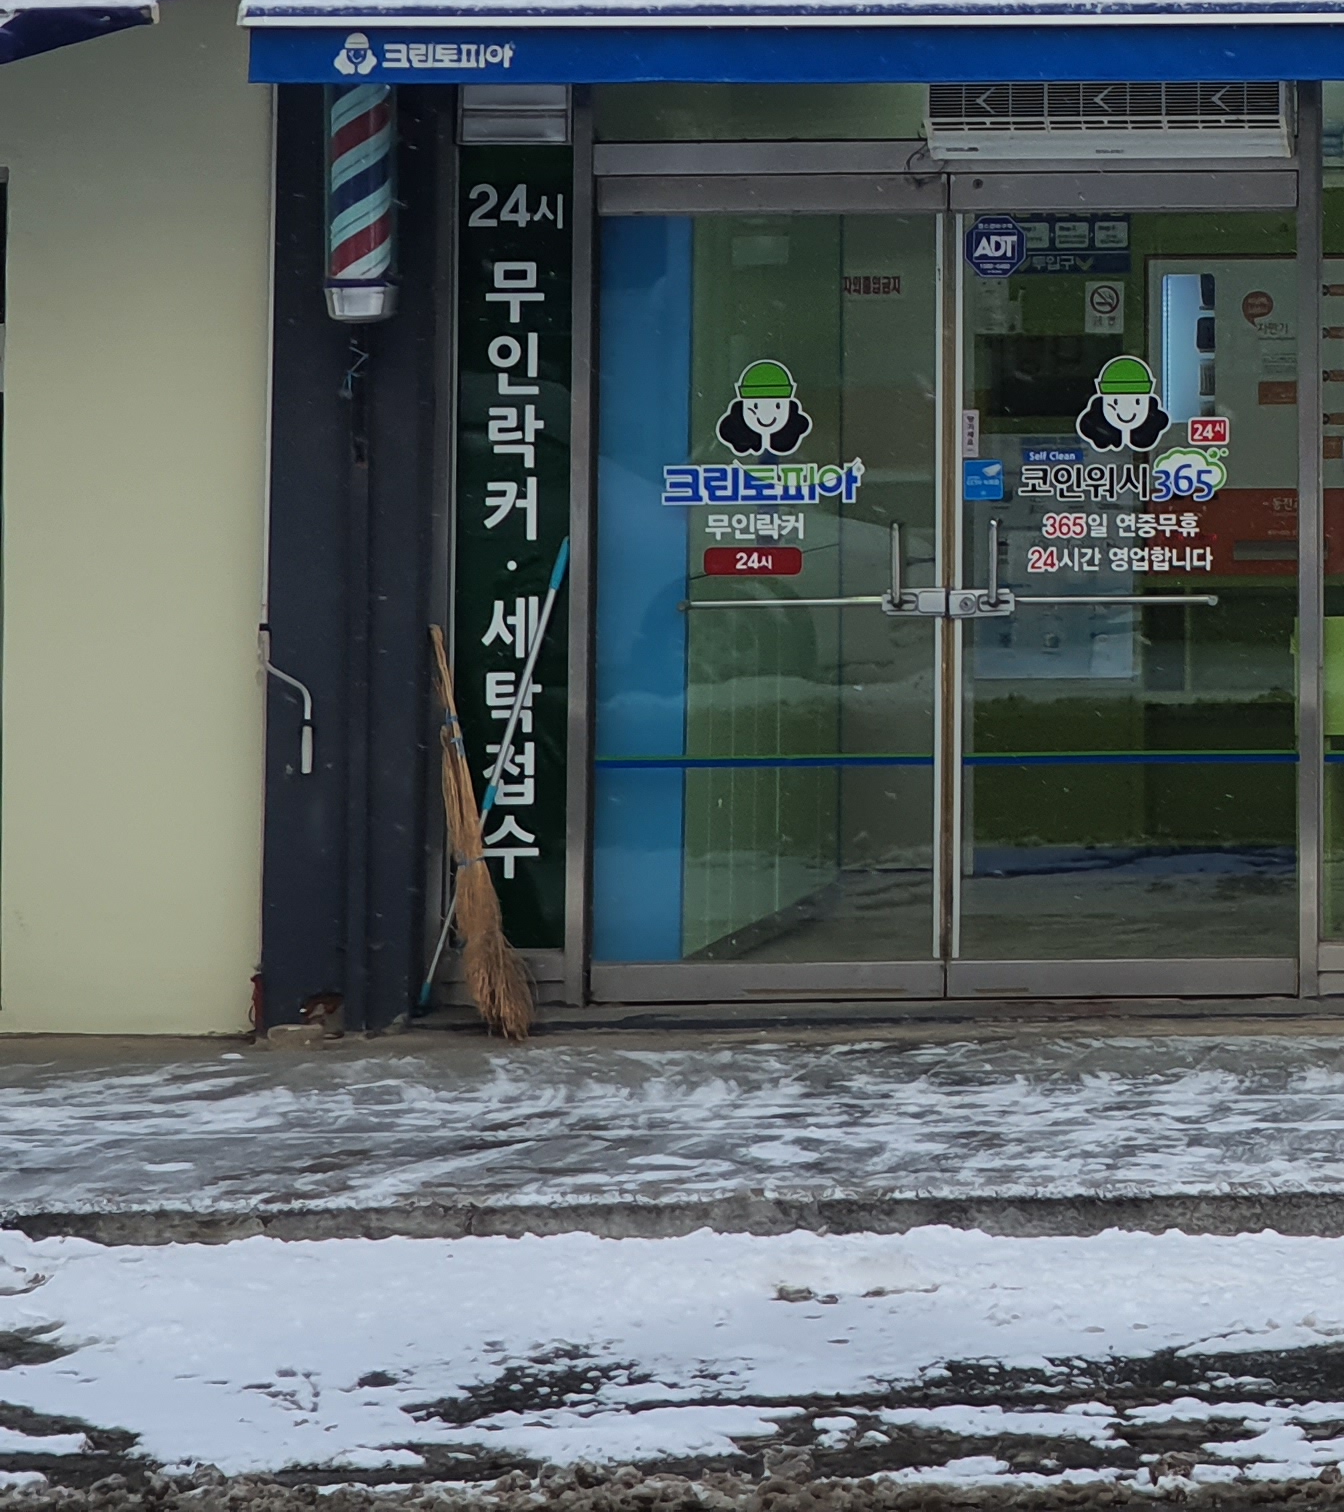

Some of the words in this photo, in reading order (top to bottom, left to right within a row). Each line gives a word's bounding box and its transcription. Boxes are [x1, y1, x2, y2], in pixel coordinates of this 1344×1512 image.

[382, 43, 514, 69] 크린토피아
[468, 183, 564, 229] 24시
[973, 235, 1017, 257] ADT
[1193, 422, 1225, 440] 24시
[1029, 451, 1047, 461] Self
[1049, 451, 1076, 461] Clean
[663, 460, 862, 505] 크린토피아
[705, 513, 804, 540] 무인락커
[1042, 514, 1107, 539] 365일
[1117, 513, 1200, 538] 연중무휴
[736, 553, 772, 570] 24시
[1028, 547, 1102, 572] 24시간
[1109, 547, 1213, 572] 영업합니다
